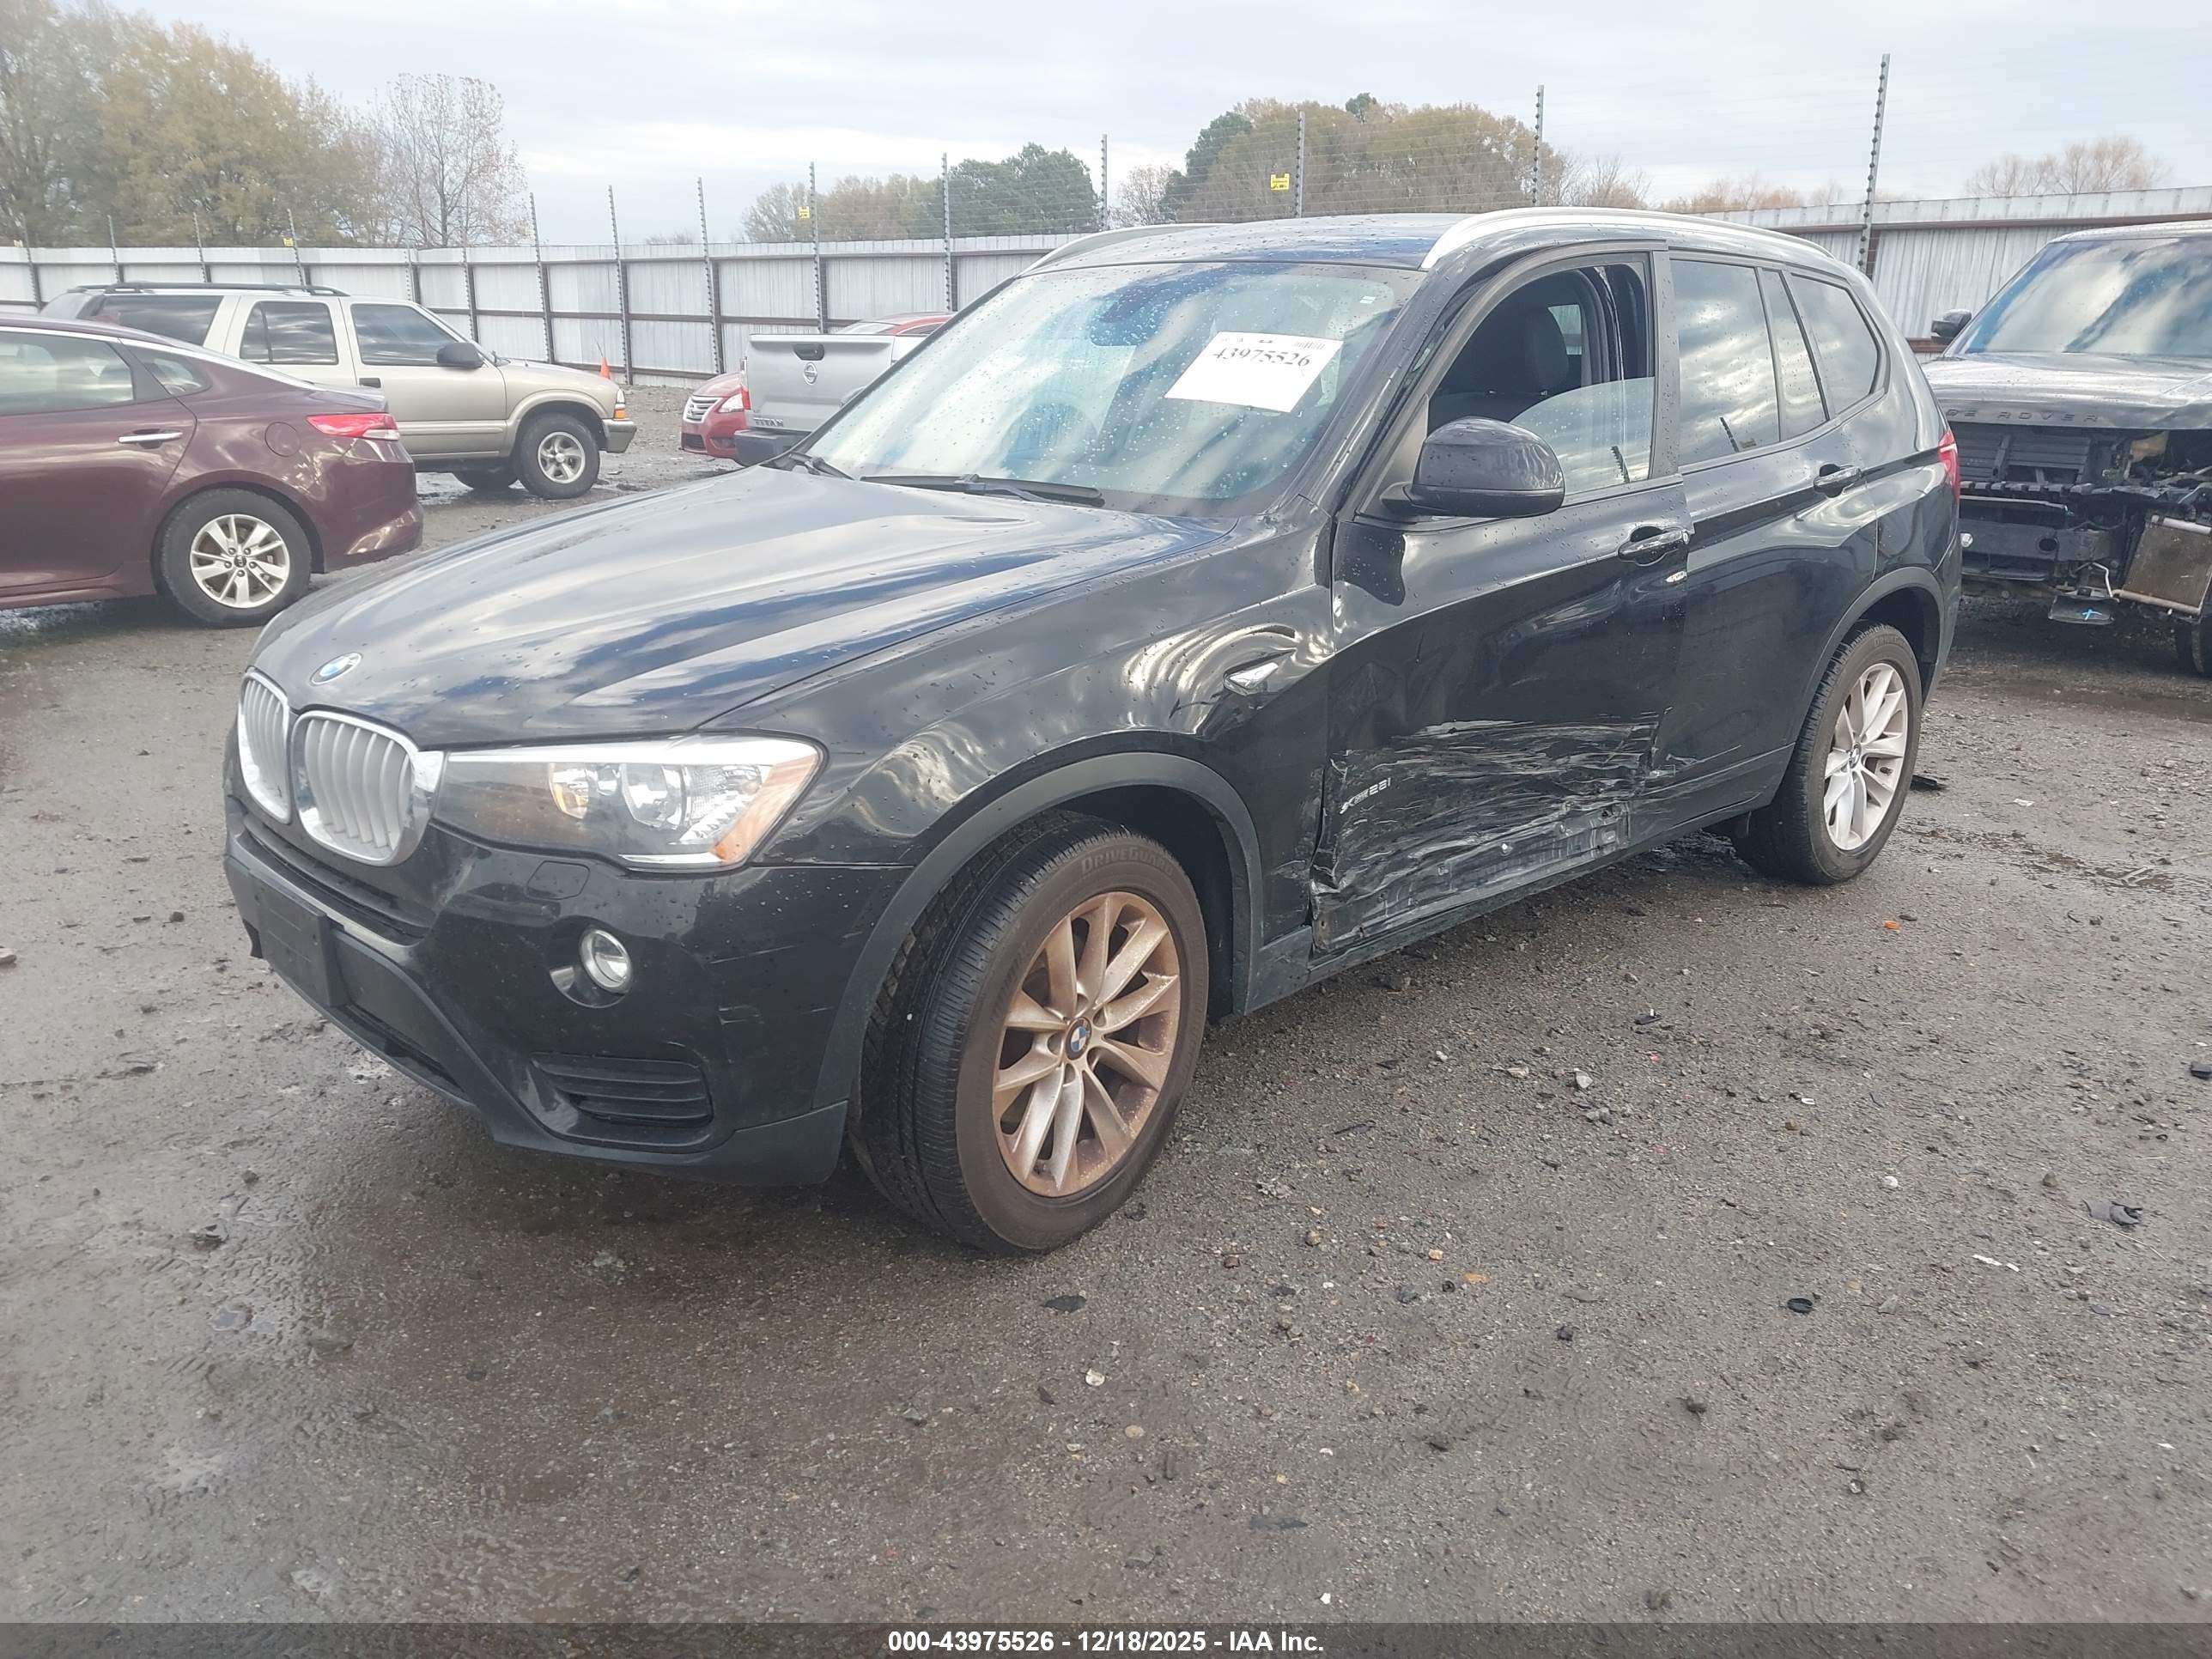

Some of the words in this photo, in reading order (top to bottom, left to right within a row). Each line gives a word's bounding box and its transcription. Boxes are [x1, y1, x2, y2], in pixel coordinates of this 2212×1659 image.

[1212, 347, 1311, 367] 43975526
[1996, 411, 2098, 422] ROVER
[752, 417, 784, 428] TITAN
